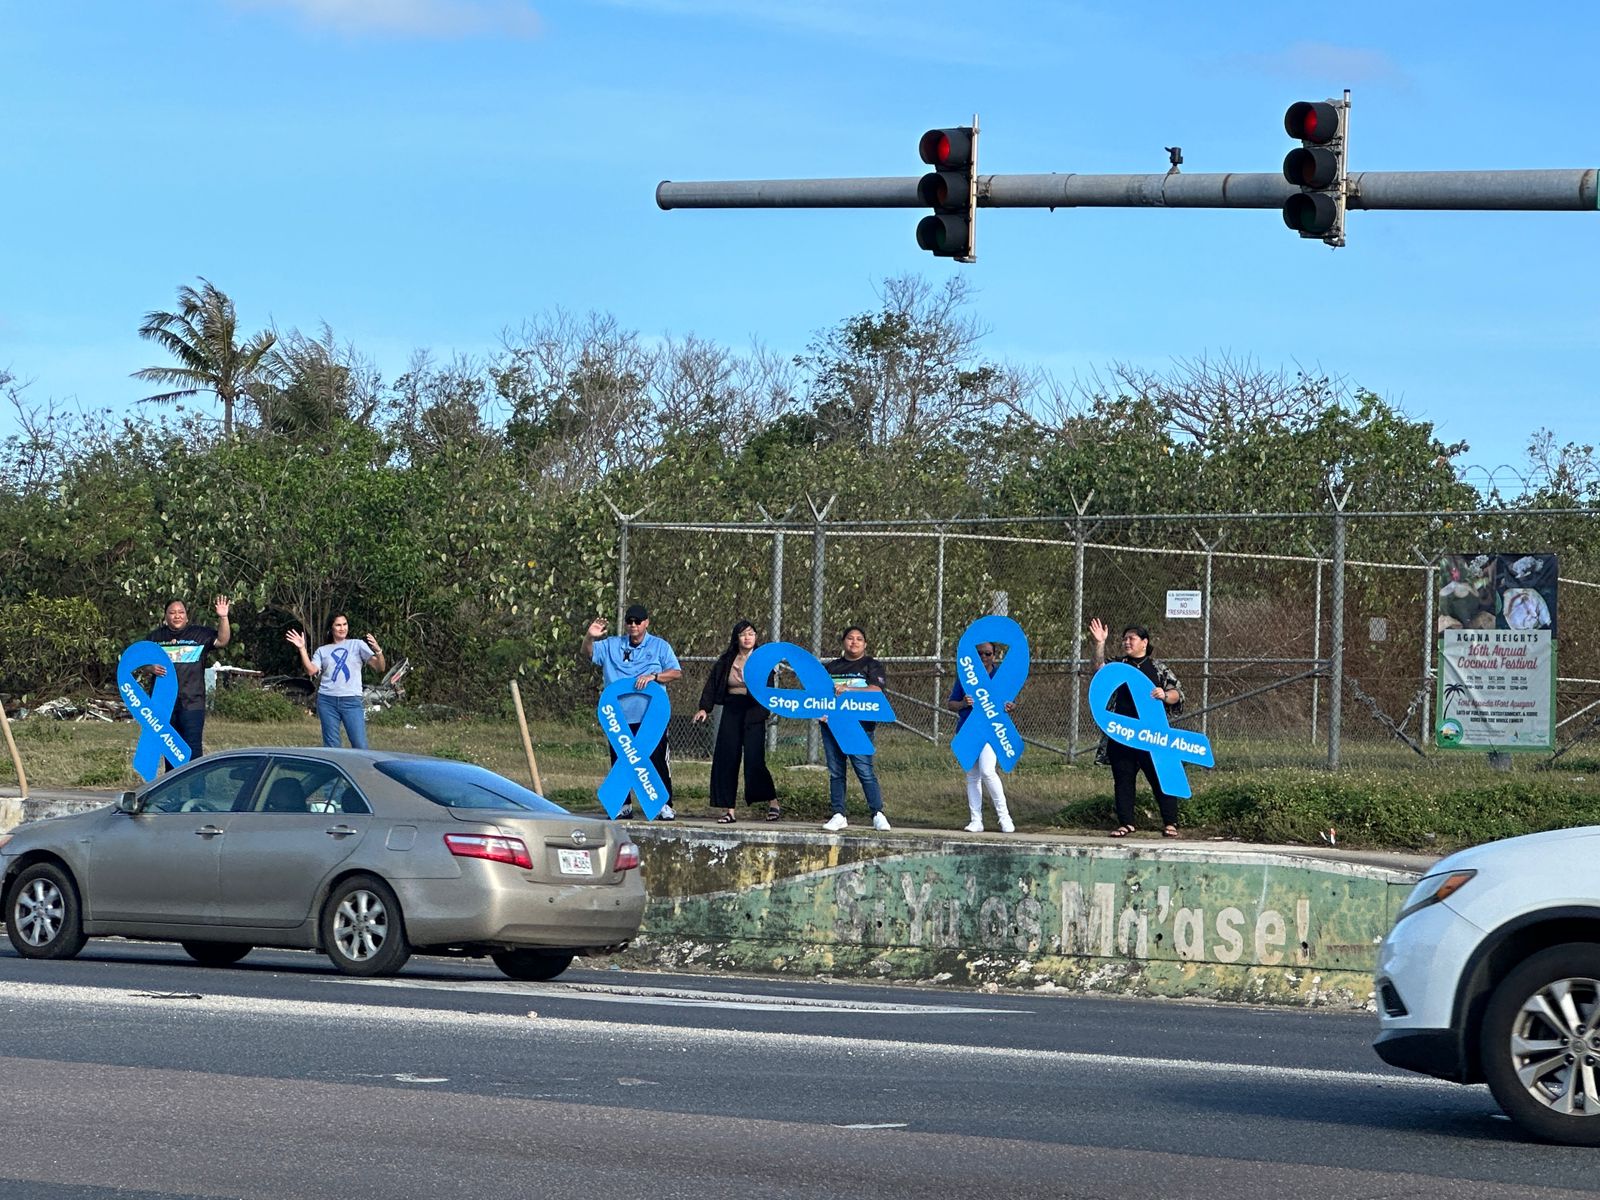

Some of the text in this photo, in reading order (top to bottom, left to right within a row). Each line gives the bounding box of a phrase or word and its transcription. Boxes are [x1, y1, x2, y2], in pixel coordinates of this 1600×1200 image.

[1457, 633, 1538, 642] AGANA HEIGHTS
[1468, 644, 1527, 656] 16th Annual
[1458, 656, 1538, 670] Coconut Festival
[768, 696, 880, 712] Stop Child Abuse
[960, 656, 1016, 758] Stop Child Abuse
[120, 683, 186, 762] Stop Child Abuse
[1107, 722, 1206, 756] Stop Child Abuse
[602, 704, 658, 801] Stop Child Abuse
[1061, 881, 1310, 966] Ma'ase!
